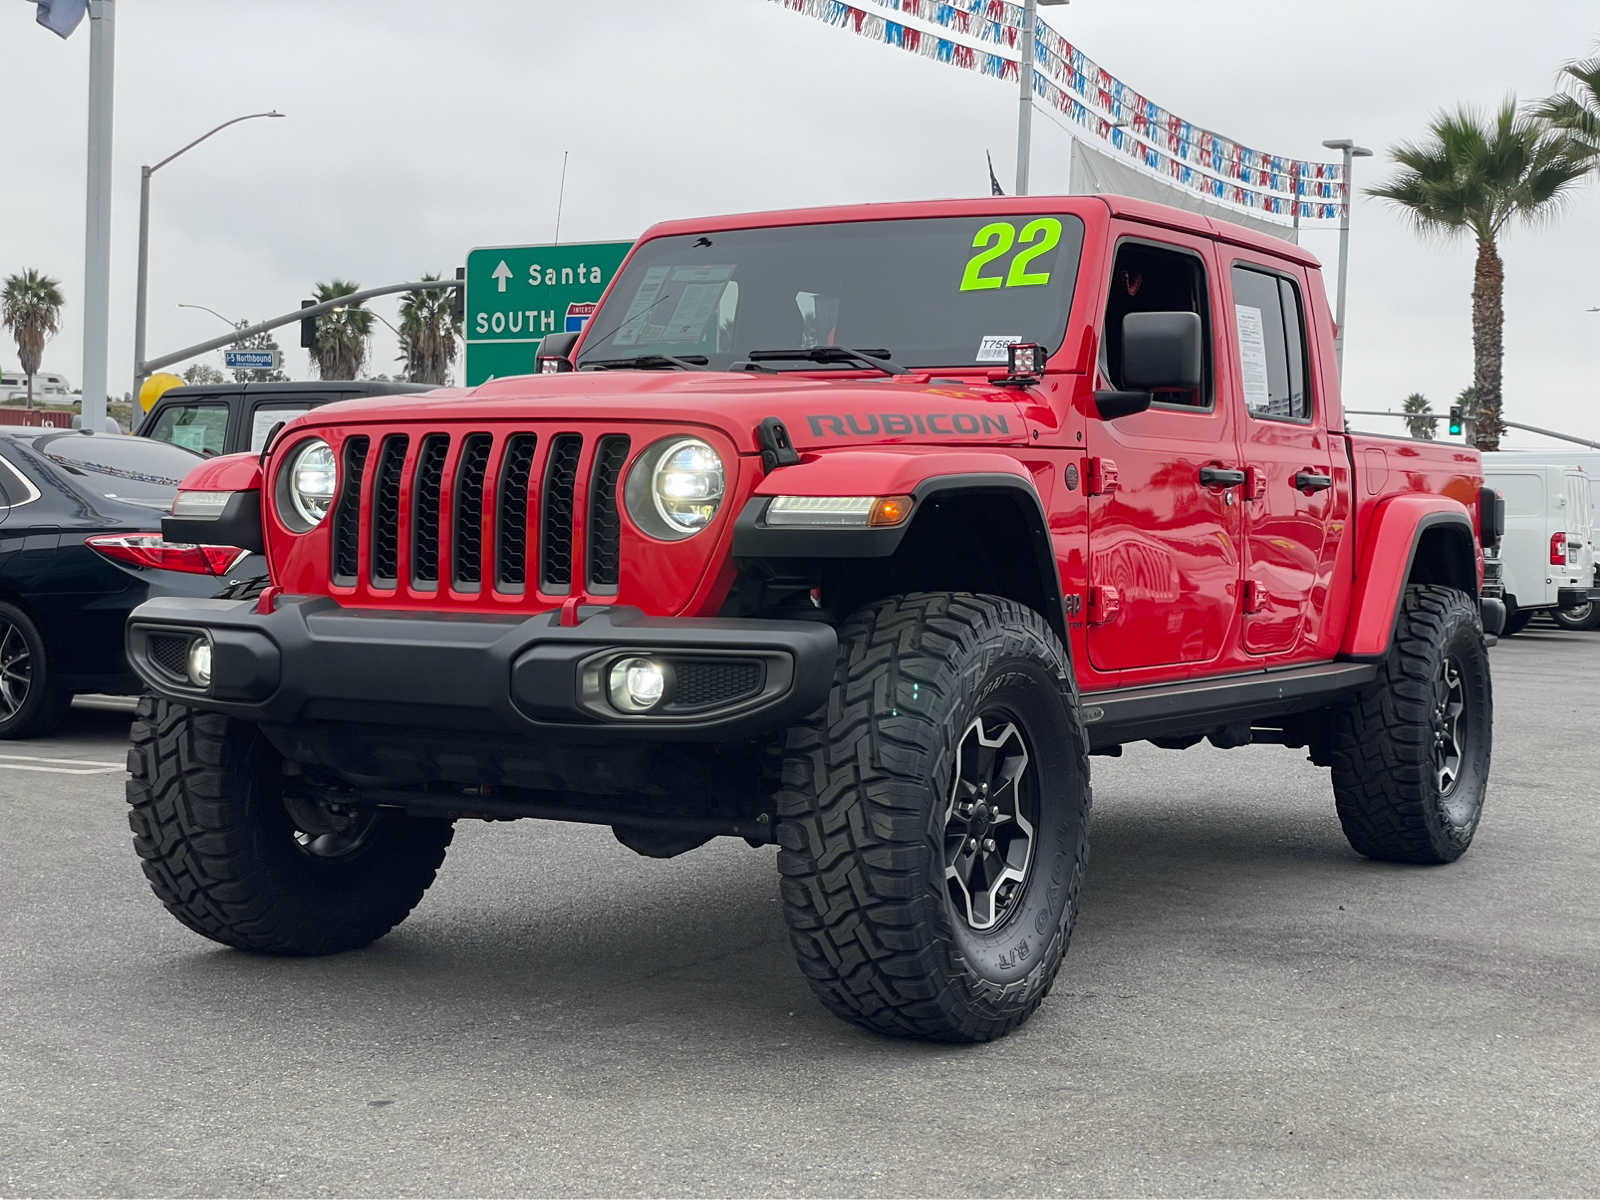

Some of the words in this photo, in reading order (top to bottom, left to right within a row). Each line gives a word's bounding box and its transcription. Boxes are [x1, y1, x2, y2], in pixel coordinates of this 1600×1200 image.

[960, 217, 1062, 291] 22
[528, 263, 601, 286] Santa
[475, 310, 555, 334] SOUTH
[236, 353, 272, 363] Northbound
[805, 413, 1009, 438] RUBICON
